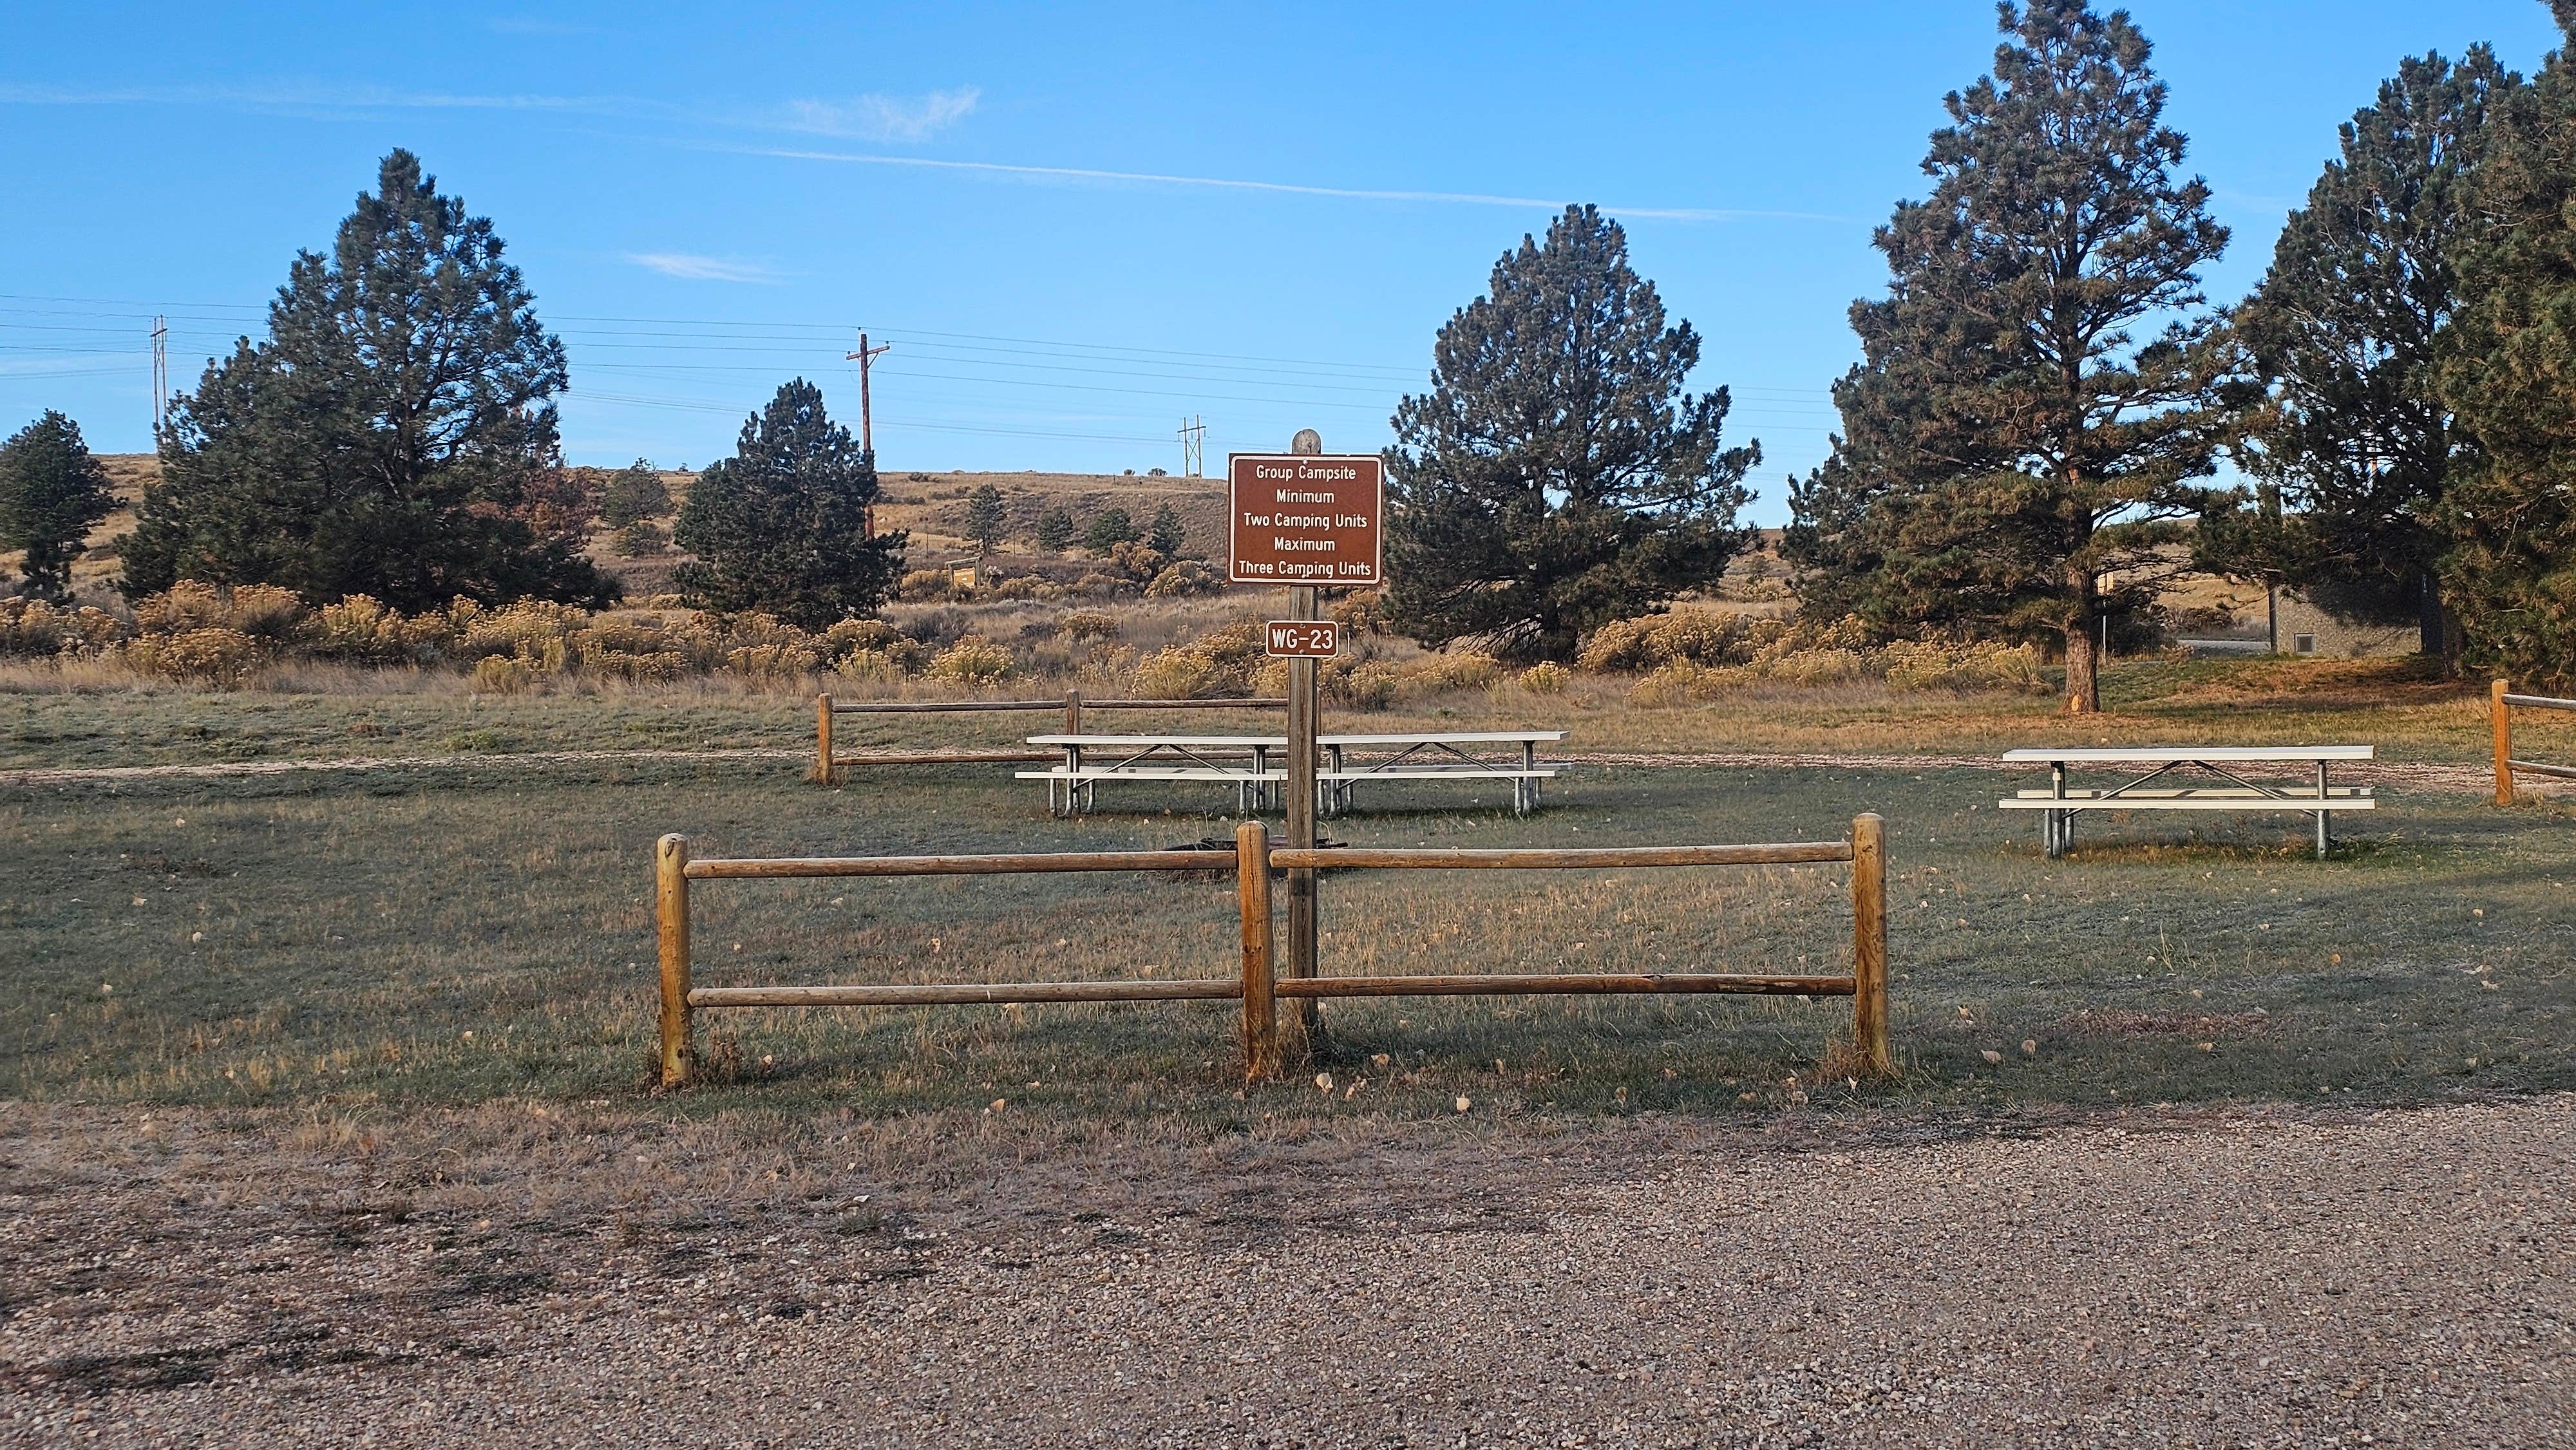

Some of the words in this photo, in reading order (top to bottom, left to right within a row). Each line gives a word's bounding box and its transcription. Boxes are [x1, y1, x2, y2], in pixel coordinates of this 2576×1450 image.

[1256, 464, 1293, 482] Group
[1298, 466, 1356, 483] Campsite
[1276, 489, 1335, 504] Minimum
[1244, 512, 1270, 527] Two
[1274, 513, 1331, 531] Camping
[1335, 513, 1368, 528] Units
[1274, 536, 1336, 551] Maximum
[1238, 560, 1273, 574] Three
[1278, 561, 1334, 578] Camping
[1339, 561, 1372, 576] Units
[1271, 628, 1333, 650] WG-23
